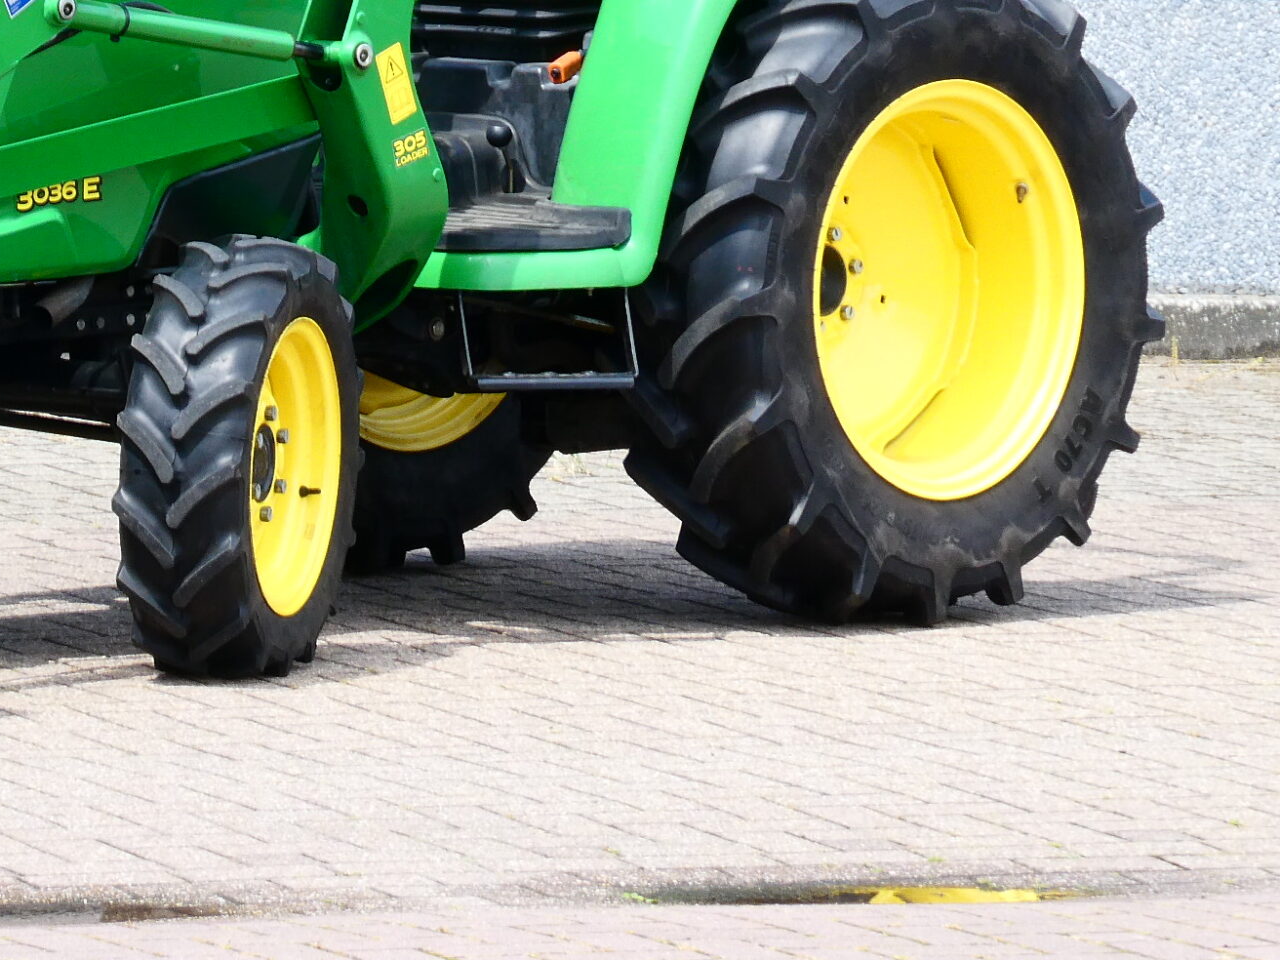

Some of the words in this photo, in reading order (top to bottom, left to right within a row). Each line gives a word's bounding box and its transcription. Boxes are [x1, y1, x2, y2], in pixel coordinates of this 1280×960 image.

[393, 130, 427, 158] 305
[395, 147, 428, 167] LOADER
[16, 180, 77, 211] 3036
[83, 176, 101, 201] E
